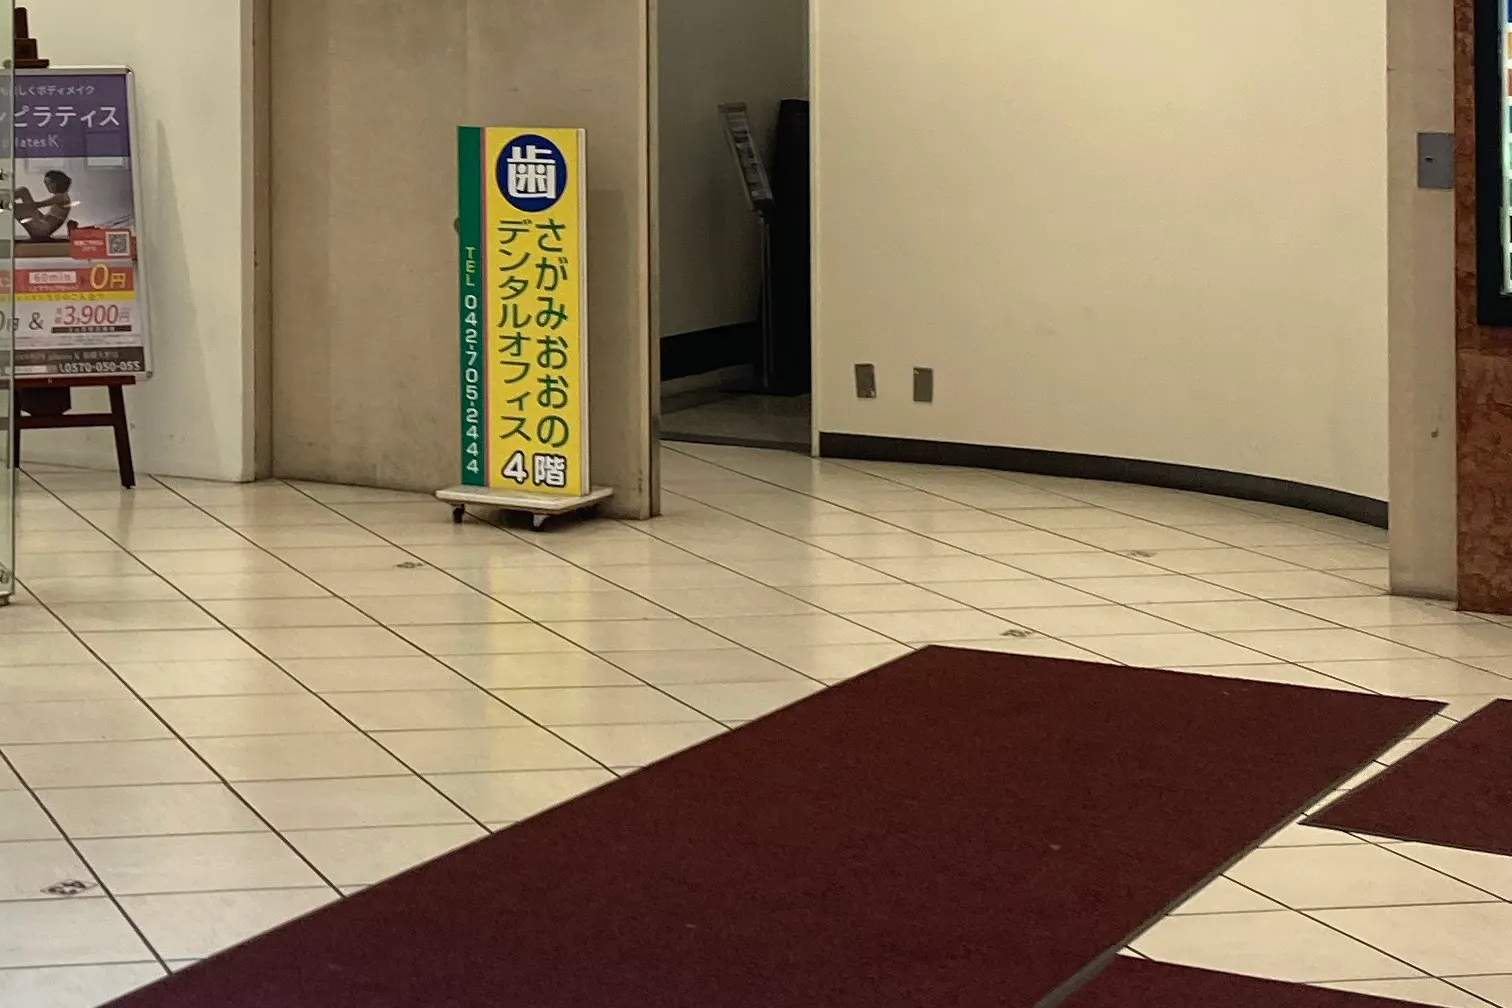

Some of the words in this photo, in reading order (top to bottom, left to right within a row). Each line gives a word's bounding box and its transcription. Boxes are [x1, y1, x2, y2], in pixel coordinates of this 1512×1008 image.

[506, 145, 557, 199] 歯
[90, 263, 127, 290] 0円
[464, 246, 477, 287] TEL
[29, 312, 43, 330] &
[497, 219, 533, 442] デンタルオフィス
[535, 218, 569, 448] さがみおおの
[502, 450, 567, 488] 4階
